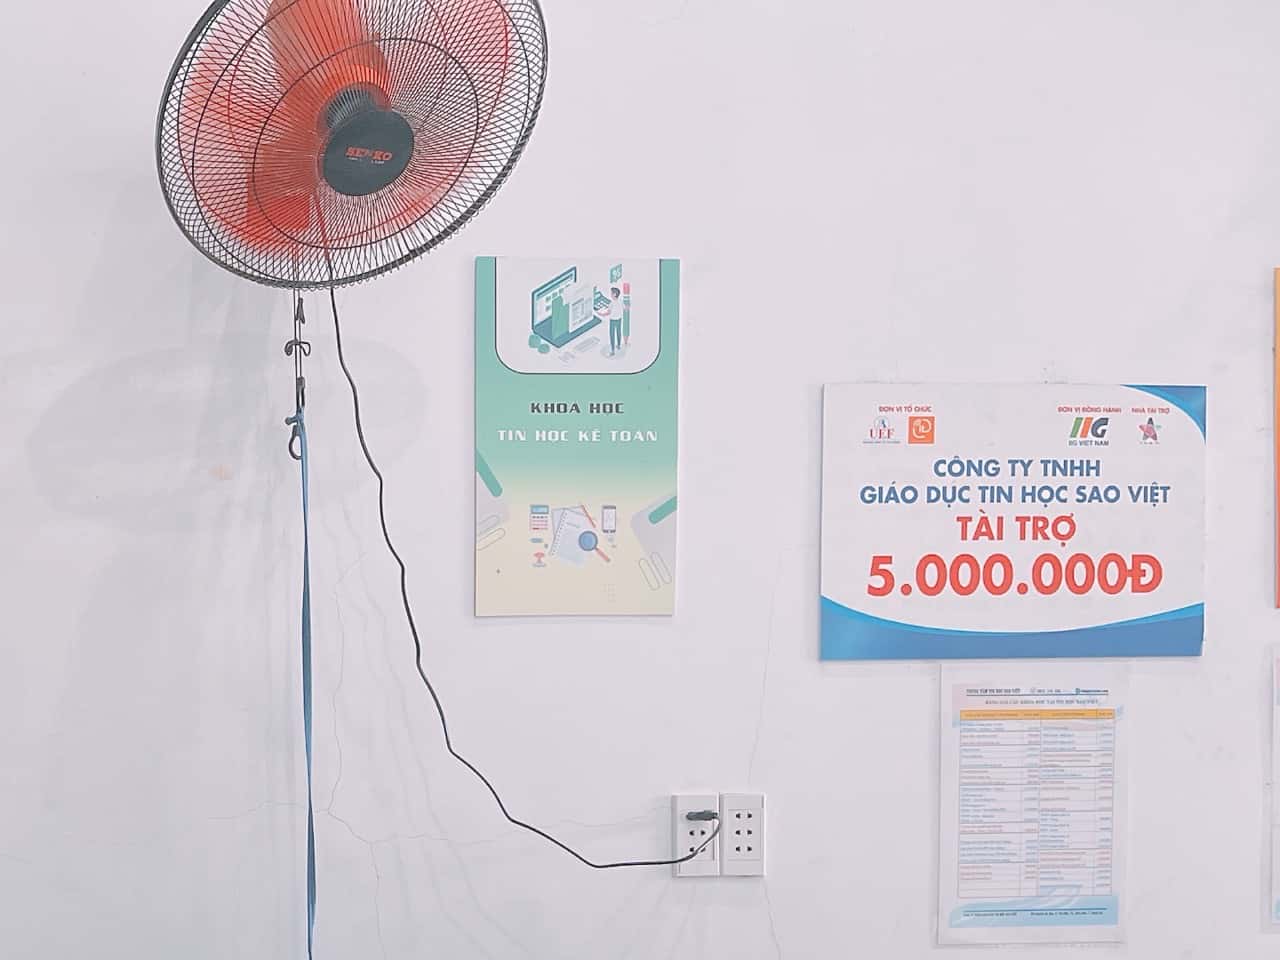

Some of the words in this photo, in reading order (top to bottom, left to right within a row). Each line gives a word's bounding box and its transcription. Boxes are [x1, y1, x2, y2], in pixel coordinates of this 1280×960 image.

[497, 429, 527, 441] TIN
[933, 456, 1001, 478] CÔNG
[1007, 459, 1034, 477] TY
[1040, 459, 1101, 477] TNHH
[860, 481, 919, 505] GIÁO
[926, 485, 971, 508] DỤC
[977, 485, 1013, 504] TIN
[1021, 485, 1069, 508] HỌC
[1075, 485, 1121, 504] SAO
[1127, 481, 1171, 508] VIỆT
[956, 508, 1004, 541] TÀI
[1015, 512, 1077, 548] TRỢ
[866, 552, 1163, 597] 5.000.000Đ
